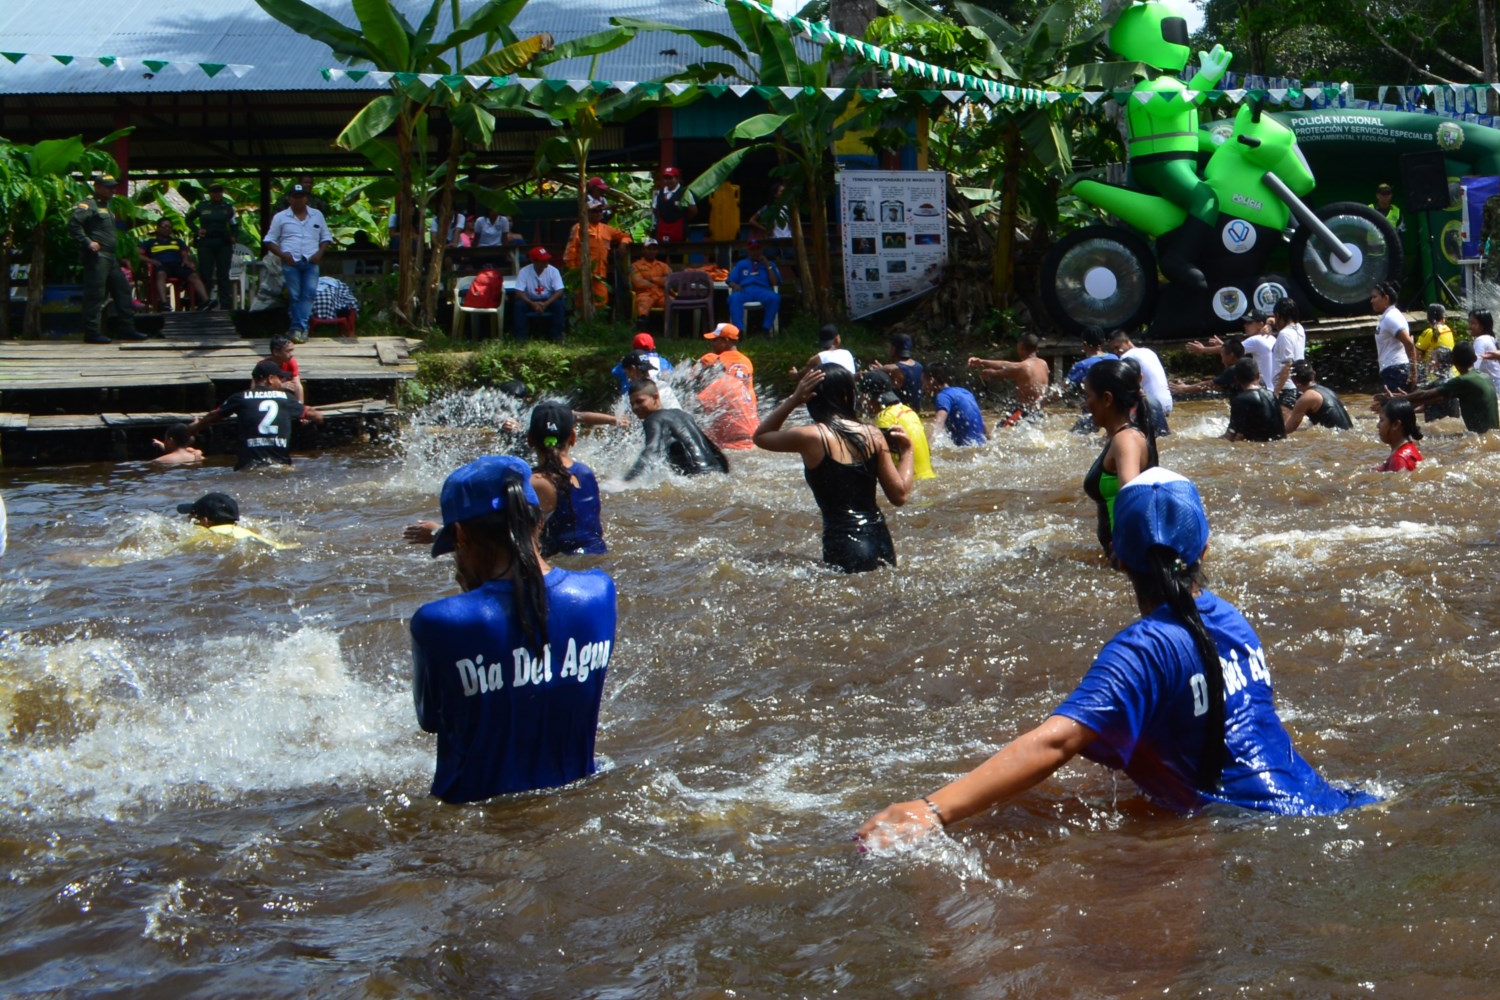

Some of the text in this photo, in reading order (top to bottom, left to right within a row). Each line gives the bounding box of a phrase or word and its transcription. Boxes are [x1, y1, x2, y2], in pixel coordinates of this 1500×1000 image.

[1291, 114, 1384, 127] POLICÍA NACIONAL
[1295, 125, 1343, 135] PROTECCIÓN
[1350, 126, 1389, 136] SERVICIOS
[1390, 130, 1433, 141] ESPECIALES
[243, 390, 254, 399] LA
[258, 399, 279, 435] 2
[456, 654, 503, 697] Dia
[513, 644, 552, 687] Del
